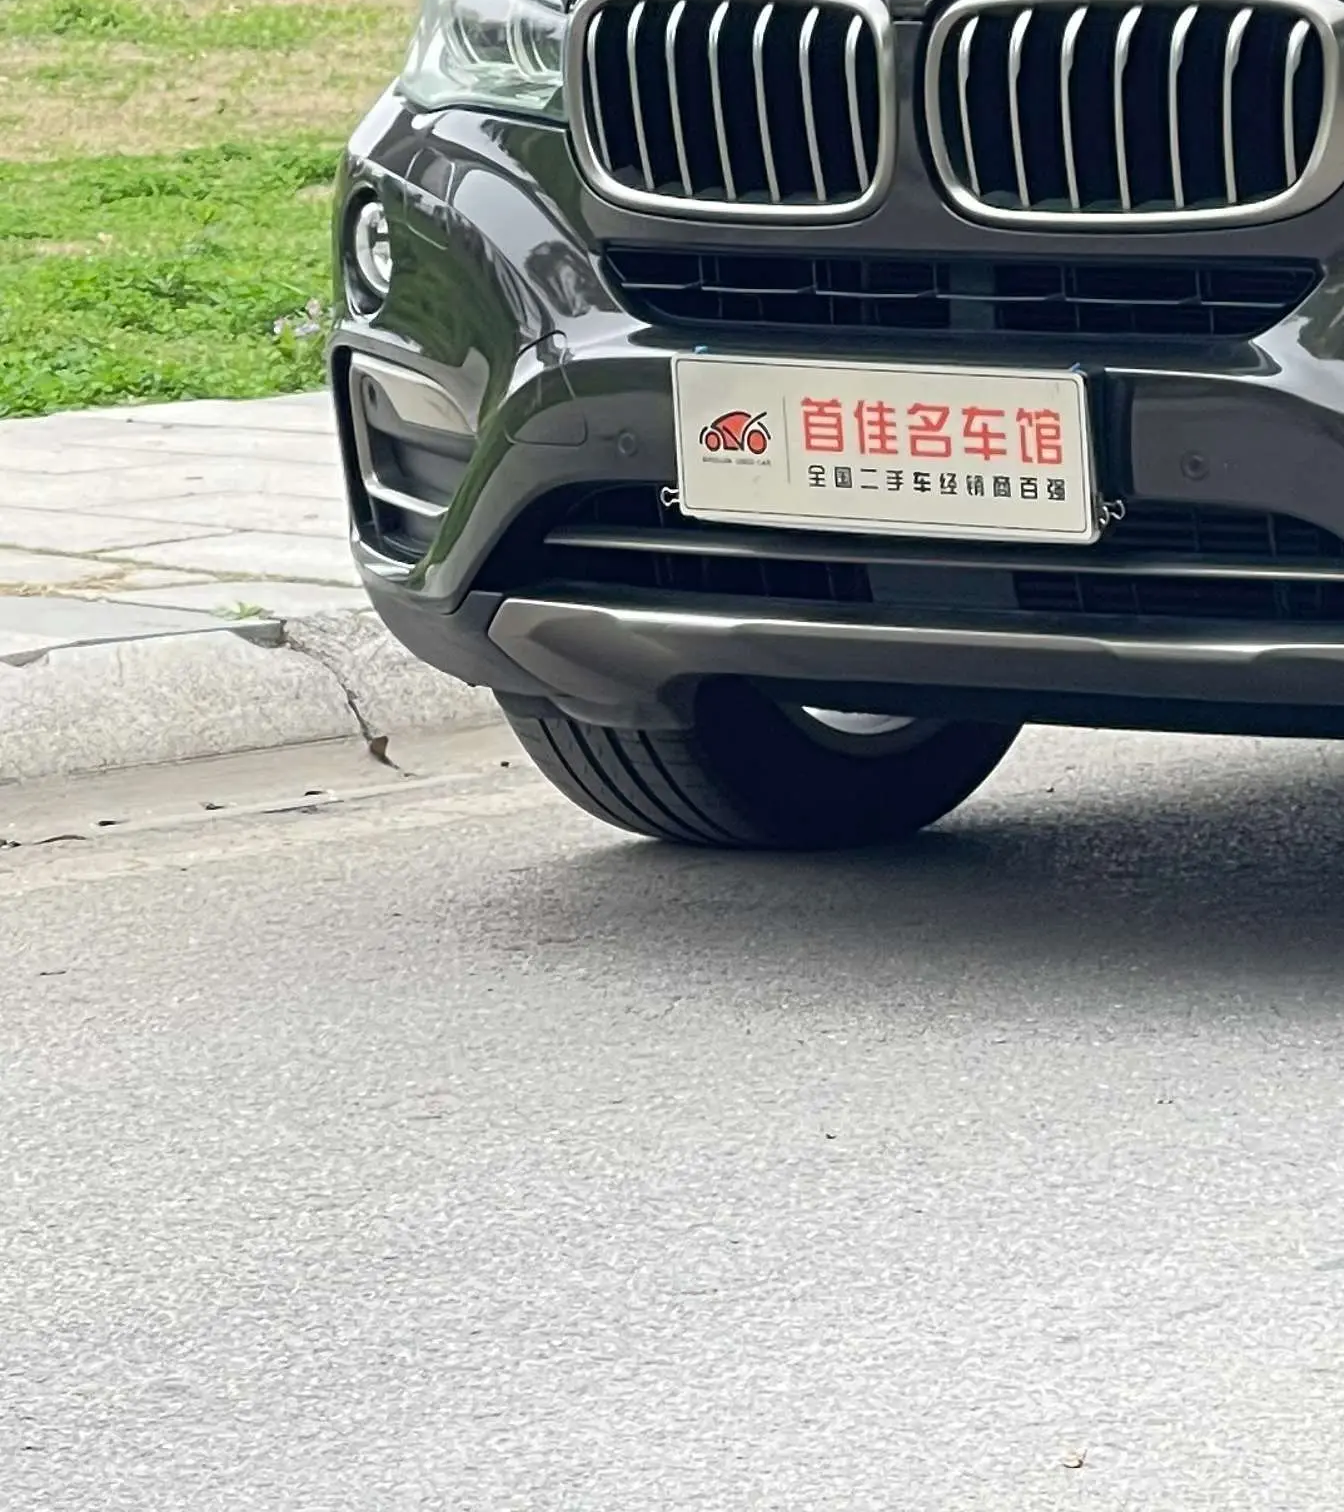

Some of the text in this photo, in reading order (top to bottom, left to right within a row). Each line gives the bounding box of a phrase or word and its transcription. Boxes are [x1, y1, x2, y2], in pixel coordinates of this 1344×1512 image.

[801, 397, 1063, 464] 首佳名车馆
[808, 464, 1065, 501] 全国二手车经销商百强
